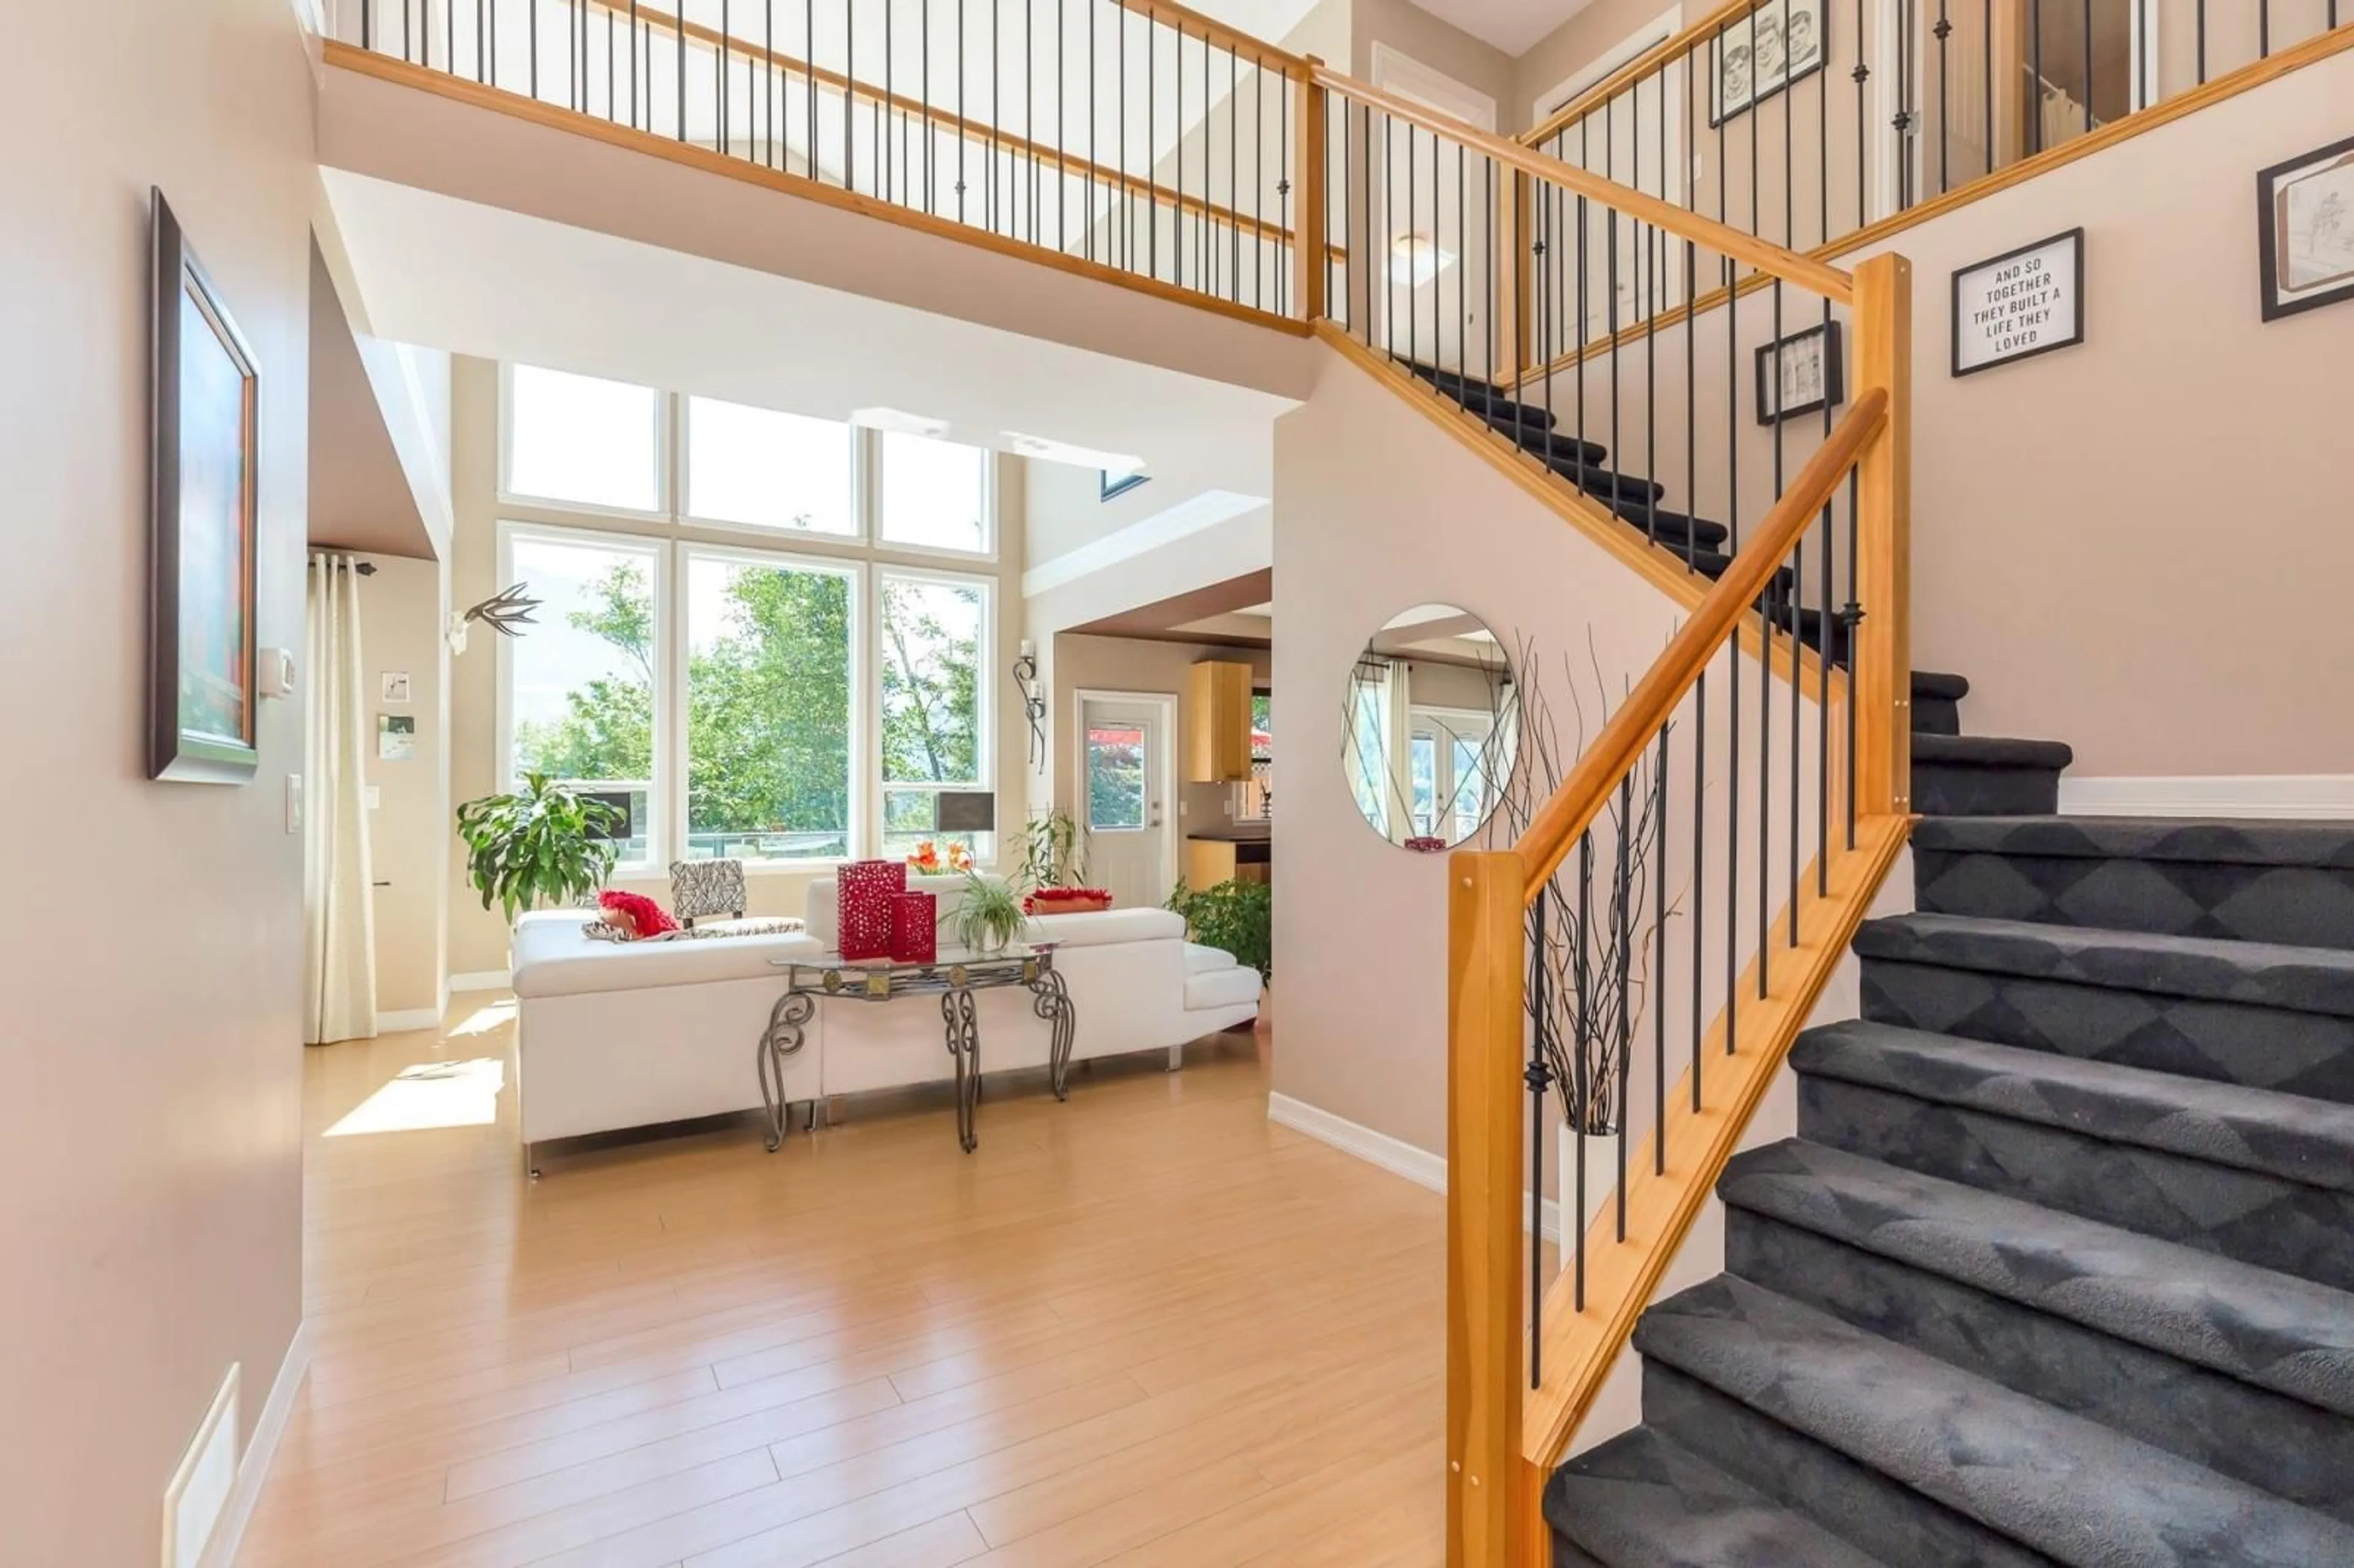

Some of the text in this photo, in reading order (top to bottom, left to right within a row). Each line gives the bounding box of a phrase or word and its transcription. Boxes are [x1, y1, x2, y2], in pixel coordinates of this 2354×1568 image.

[1995, 258, 2042, 284] AND SO
[1986, 273, 2051, 303] TOGETHER
[1973, 287, 2061, 325] THEY BUILT A
[1986, 308, 2051, 338] LIFE THEY
[1995, 330, 2038, 352] LOVED
